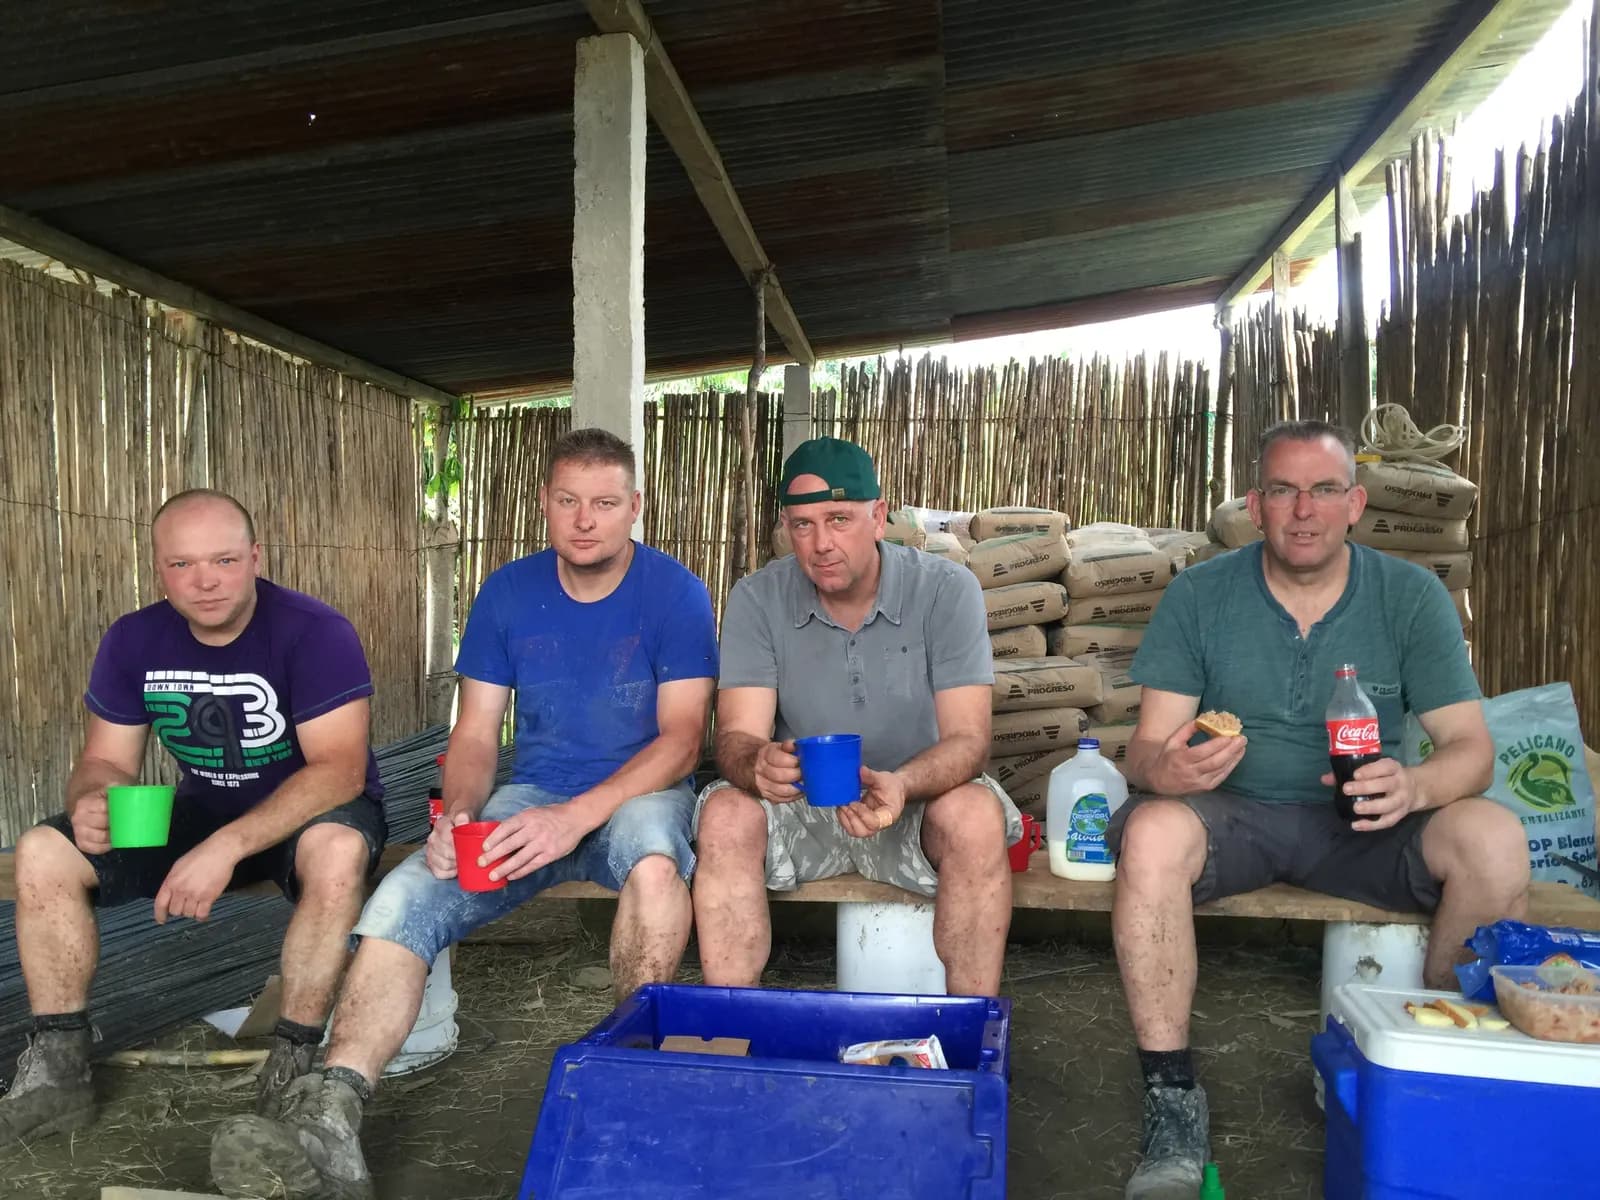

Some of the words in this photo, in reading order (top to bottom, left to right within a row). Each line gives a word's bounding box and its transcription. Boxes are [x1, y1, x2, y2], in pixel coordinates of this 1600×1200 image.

[1393, 524, 1444, 534] PROGRESO
[1009, 554, 1050, 570] PROGRESO
[1094, 576, 1137, 588] PROGRESO
[987, 604, 1029, 618] PROGRESO
[1108, 606, 1151, 616] PROGRESO
[146, 682, 169, 691] DOWN
[173, 682, 195, 692] TOWN
[1027, 683, 1075, 696] PROGRESO
[993, 729, 1041, 742] PROGRESO
[1498, 734, 1576, 766] PELICANO
[1520, 808, 1586, 825] ERTILIZANTE
[1528, 838, 1553, 852] OP
